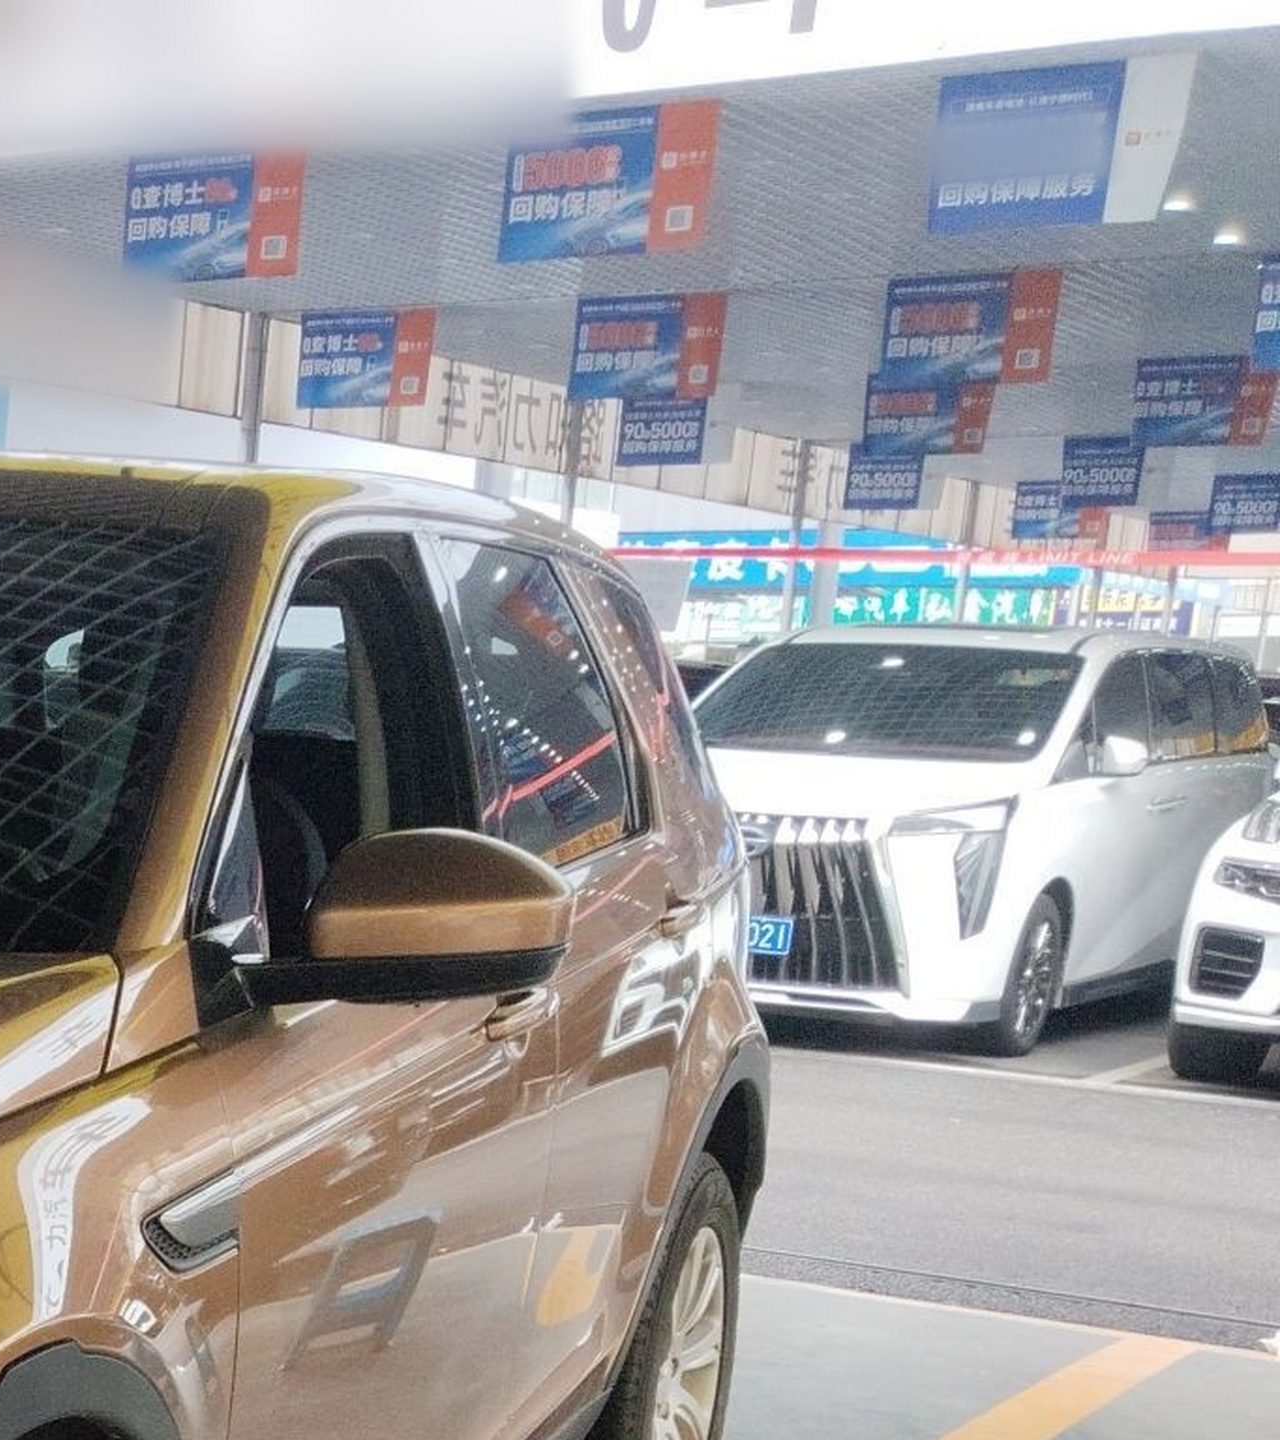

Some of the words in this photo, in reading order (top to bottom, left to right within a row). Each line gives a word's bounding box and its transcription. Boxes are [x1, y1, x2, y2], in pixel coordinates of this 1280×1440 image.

[937, 173, 1098, 209] 回购保障服务
[127, 212, 211, 243] 回购保障
[1028, 552, 1081, 564] LIMIT
[1088, 552, 1137, 565] LINE
